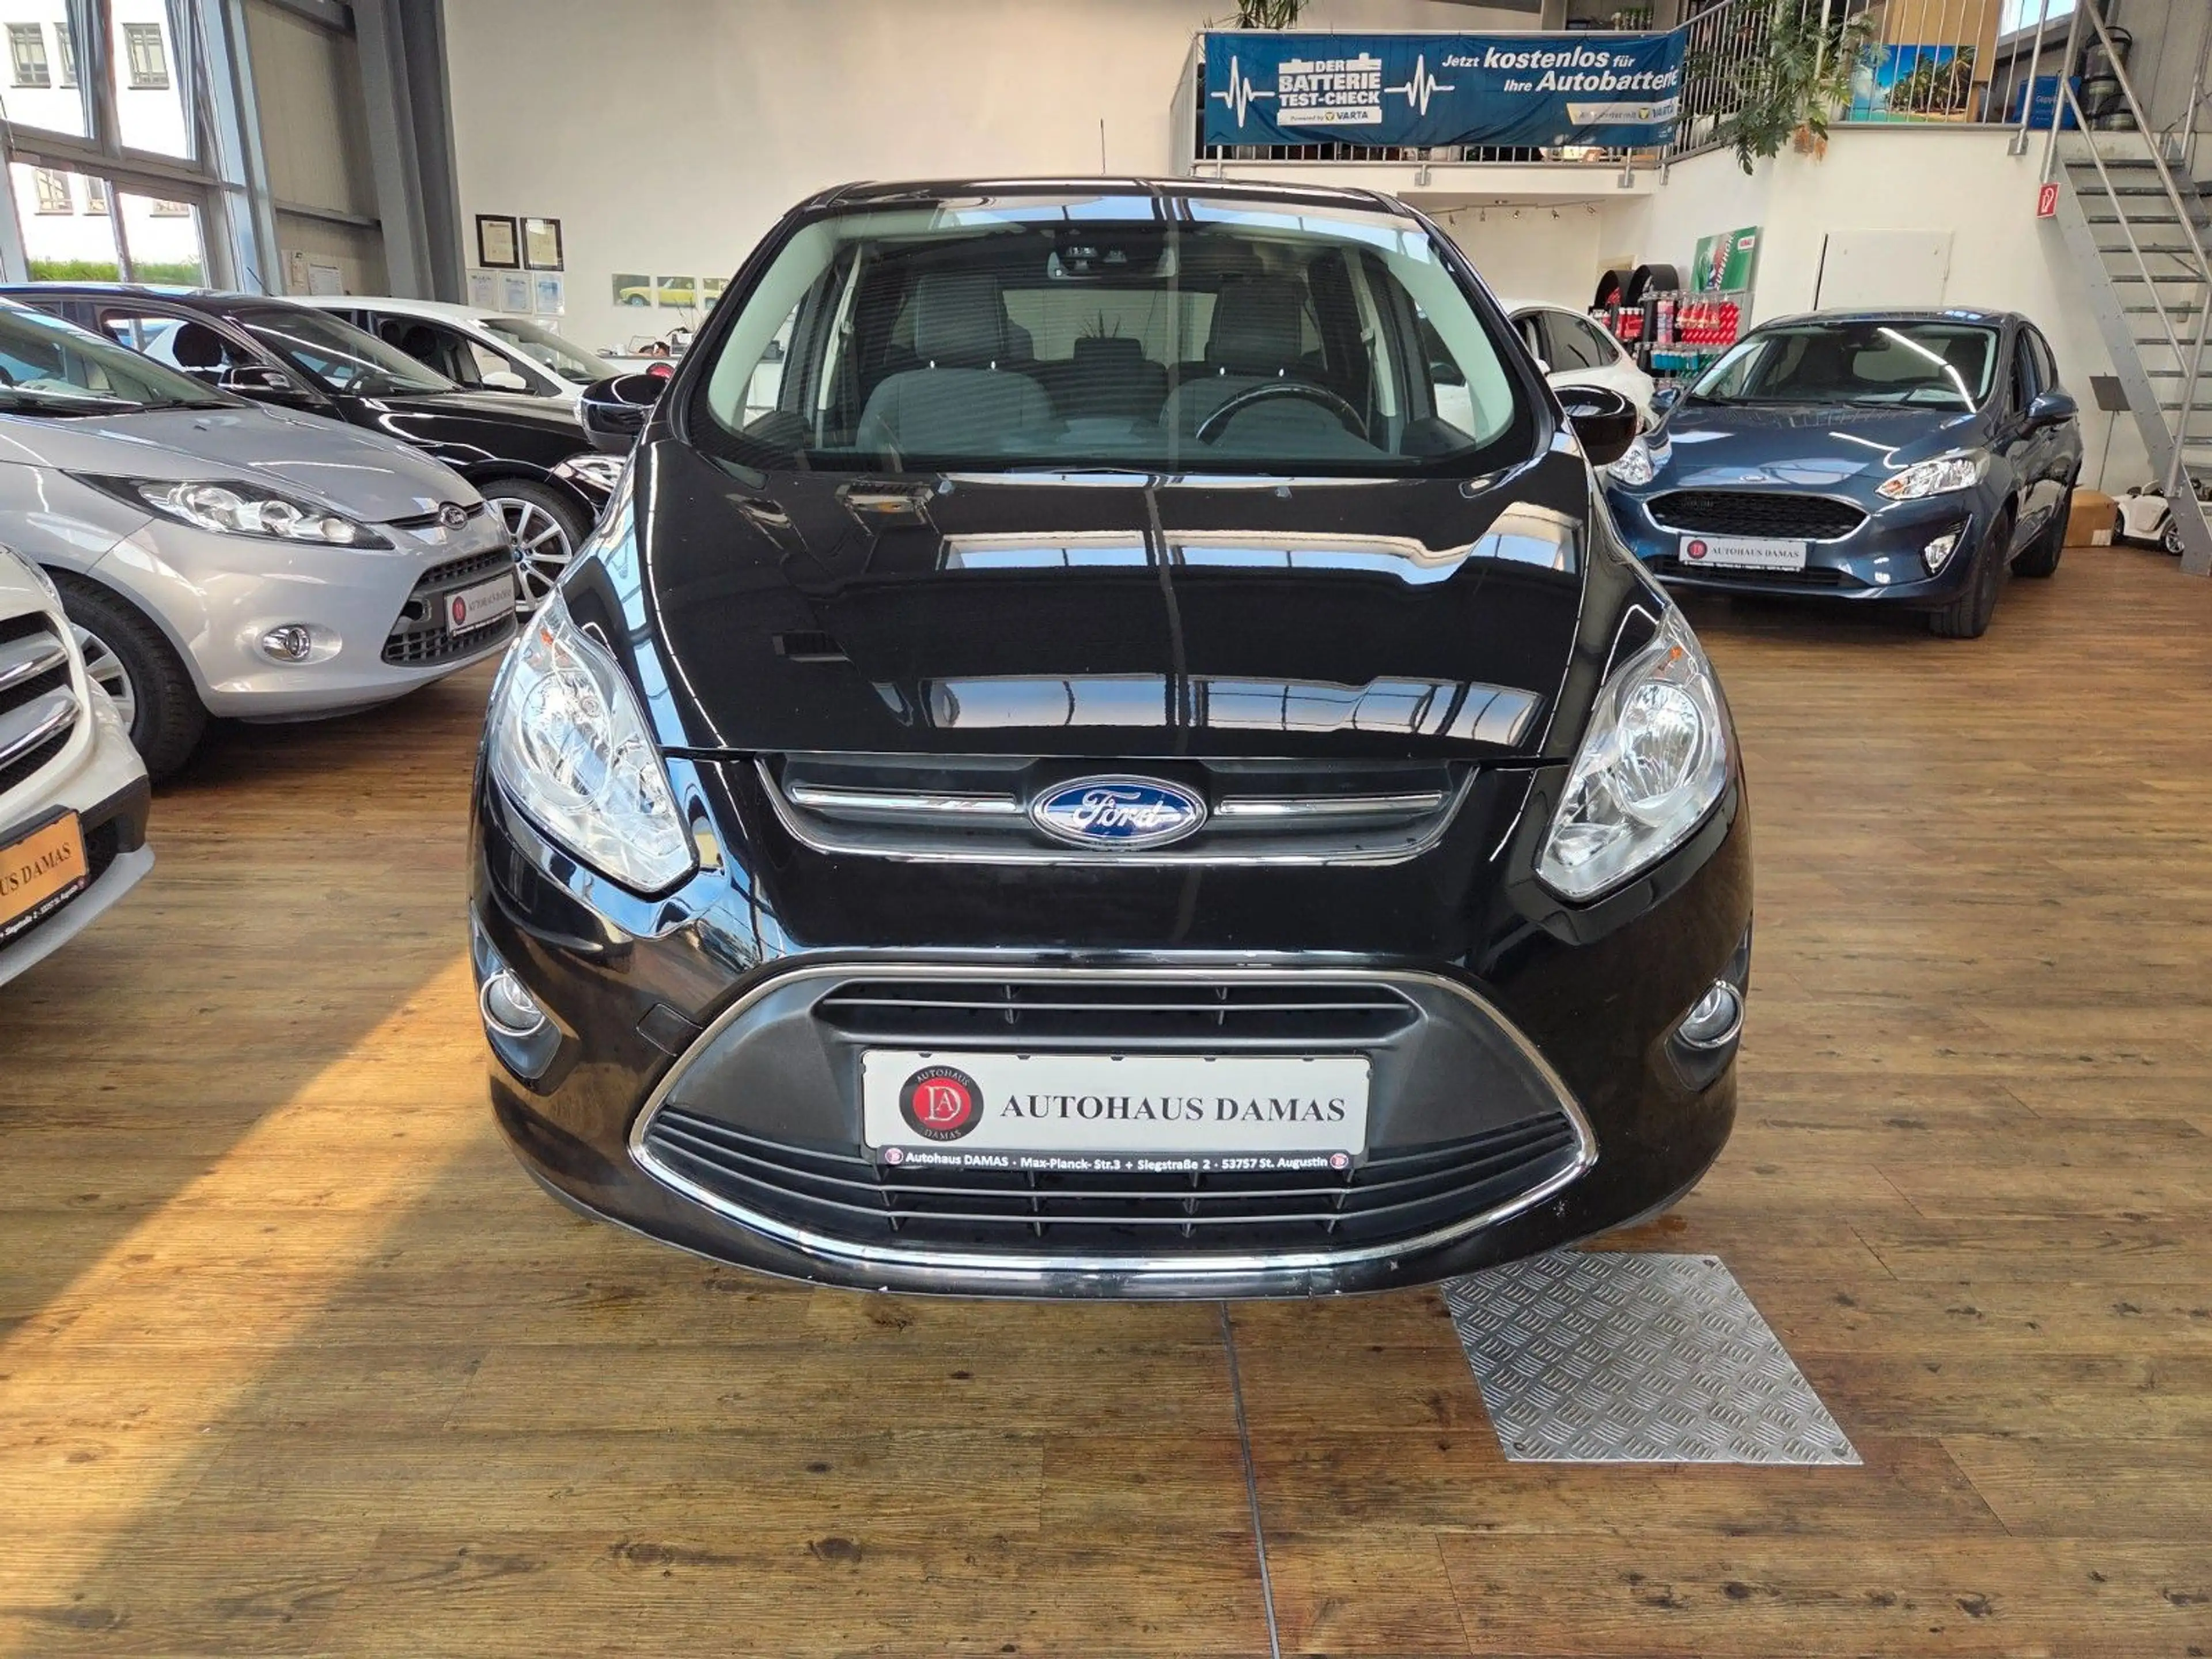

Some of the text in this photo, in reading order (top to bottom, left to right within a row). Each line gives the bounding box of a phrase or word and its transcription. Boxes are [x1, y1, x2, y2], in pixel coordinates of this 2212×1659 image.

[1442, 46, 1635, 69] Jetzt kostenlos für
[1315, 60, 1344, 73] DER
[1279, 72, 1381, 92] BATTERIE
[1504, 79, 1532, 92] Ihre
[1279, 90, 1380, 107] TEST-CHECK
[1336, 111, 1369, 119] VARTA
[1711, 546, 1800, 558] AUTOHAUS DAMAS
[1073, 789, 1164, 827] Ford
[21, 842, 72, 884] DAMAS
[916, 1069, 970, 1086] AUTOHAUS
[1000, 1095, 1346, 1121] AUTOHAUS DAMAS
[924, 1128, 962, 1140] DAMAS
[906, 1152, 961, 1164] Autohaus
[964, 1155, 1009, 1166] DAMAS
[1138, 1159, 1198, 1171] Siegstraße
[1202, 1159, 1210, 1169] 2
[1221, 1158, 1257, 1169] 53757
[1259, 1157, 1275, 1169] St.
[1277, 1156, 1328, 1169] Augustin
